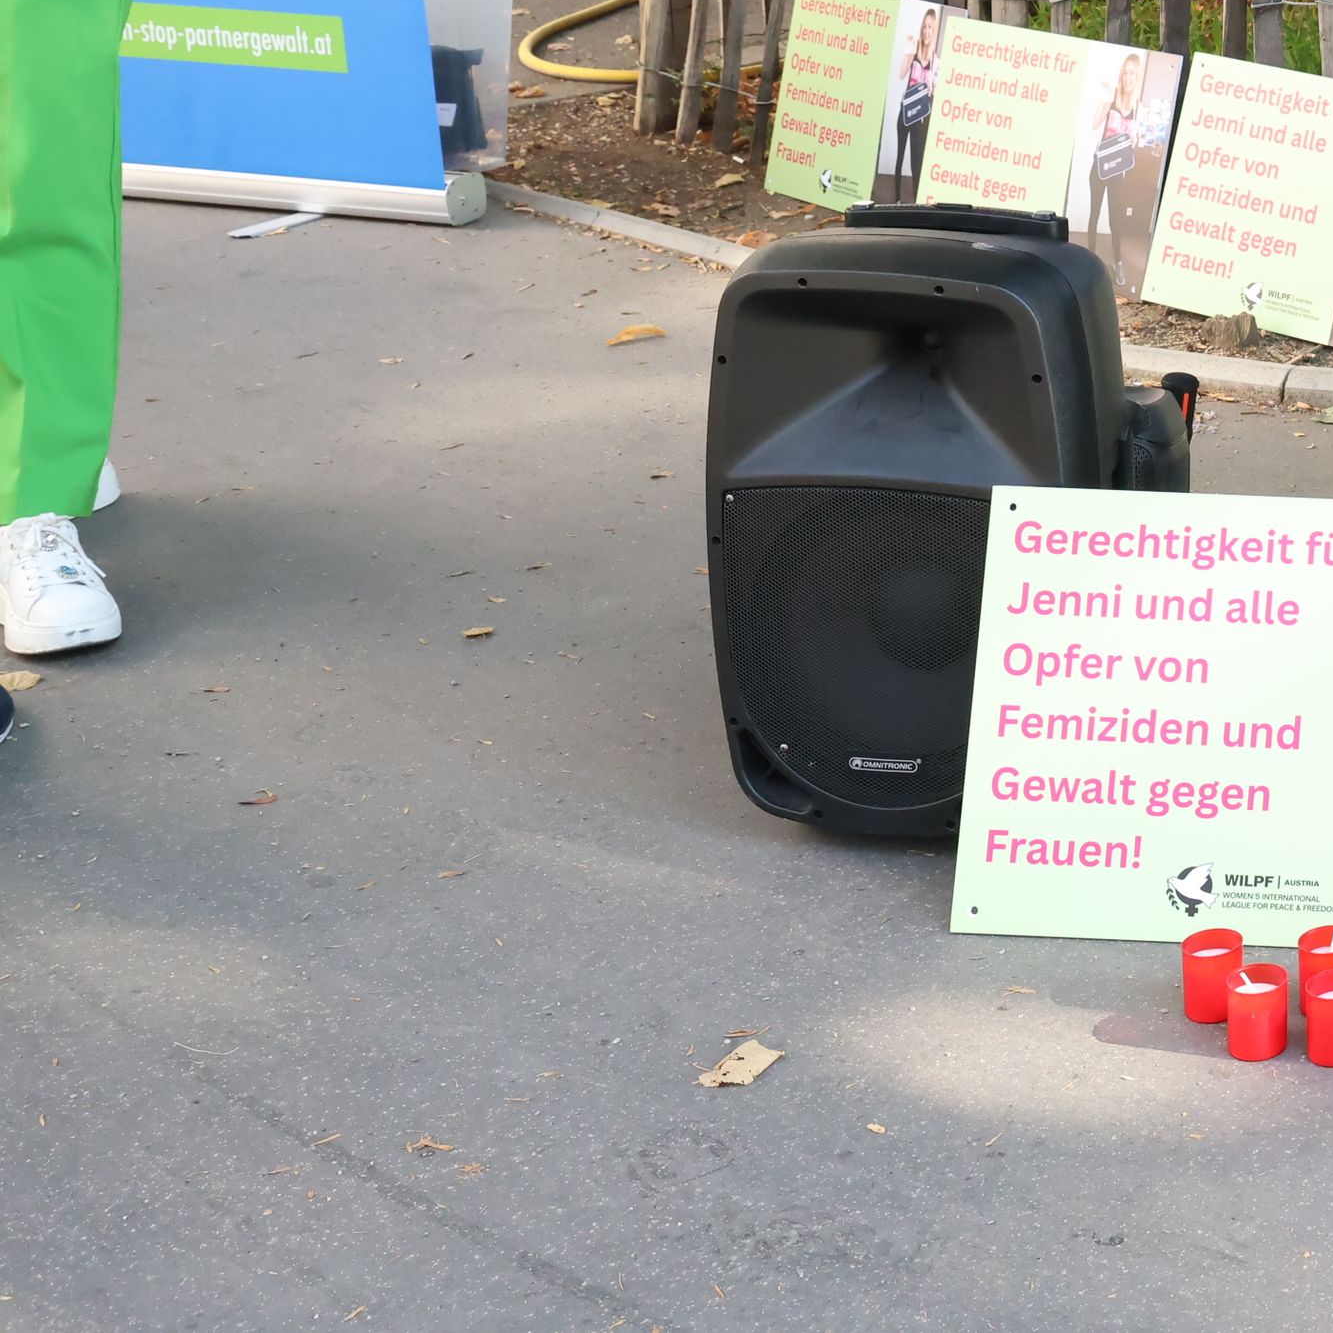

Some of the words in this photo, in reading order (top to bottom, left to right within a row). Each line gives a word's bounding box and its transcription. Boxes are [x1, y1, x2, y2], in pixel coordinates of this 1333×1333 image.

[874, 8, 891, 28] für
[795, 24, 825, 45] Jenni
[827, 33, 848, 50] und
[850, 38, 870, 56] alle
[952, 35, 1050, 70] Gerechtigkeit
[1053, 52, 1077, 74] für
[790, 53, 822, 75] Opfer
[824, 64, 843, 81] von
[946, 68, 987, 91] Jenni
[989, 79, 1019, 97] und
[1021, 82, 1049, 103] alle
[786, 83, 840, 112] Femiziden
[842, 100, 864, 118] und
[1200, 74, 1330, 117] Gerechtigkeit
[781, 112, 818, 139] Gewalt
[818, 124, 852, 148] gegen
[941, 100, 983, 124] Opfer
[986, 110, 1013, 130] von
[1191, 109, 1246, 136] Jenni
[1249, 125, 1288, 144] und
[1290, 130, 1327, 153] alle
[776, 142, 817, 168] Frauen!
[936, 131, 1009, 163] Femiziden
[1012, 152, 1043, 170] und
[1184, 143, 1240, 171] Opfer
[1244, 159, 1280, 180] von
[930, 163, 980, 191] Gewalt
[982, 178, 1027, 202] gegen
[1177, 177, 1275, 216] Femiziden
[1279, 205, 1318, 225] und
[1169, 211, 1236, 244] Gewalt
[1238, 230, 1298, 258] gegen
[1161, 245, 1234, 279] Frauen!
[1013, 520, 1295, 572] Gerechtigkeit
[1006, 582, 1124, 620] Jenni
[1134, 587, 1213, 624] und
[1224, 588, 1301, 628] alle
[1002, 643, 1123, 687] Opfer
[1133, 654, 1210, 685] von
[997, 705, 1211, 748] Femiziden
[1220, 715, 1302, 752] und
[863, 761, 914, 771] OMNITRONIC
[990, 766, 1137, 808] Gewalt
[1145, 778, 1272, 819] gegen
[984, 829, 1143, 870] Frauen!
[1224, 874, 1274, 888] WILPF
[1284, 879, 1320, 887] AUSTRIA
[1262, 893, 1320, 903] INTERNATIONAL
[1222, 901, 1251, 909] LEAGUE
[1252, 902, 1268, 910] FOR
[1270, 903, 1294, 911] PEACE
